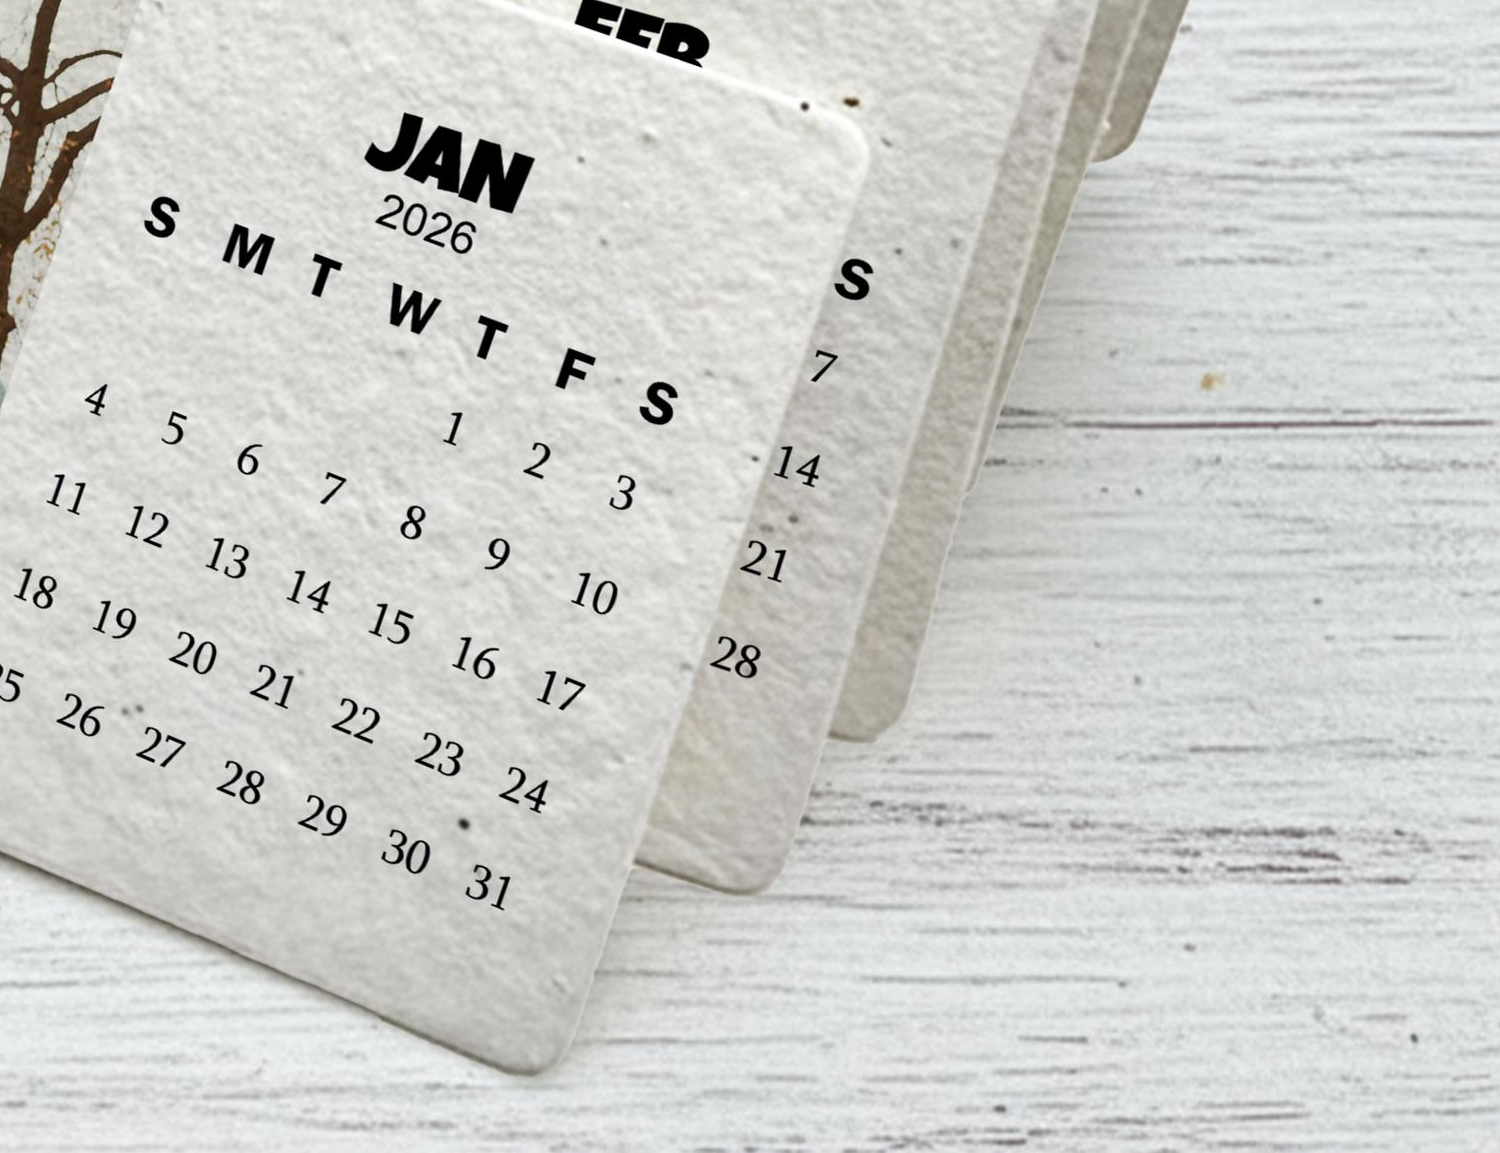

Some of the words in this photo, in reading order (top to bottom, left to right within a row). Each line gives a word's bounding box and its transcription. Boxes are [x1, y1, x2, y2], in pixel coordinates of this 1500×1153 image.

[364, 112, 535, 214] JAN
[375, 194, 477, 255] 2026
[143, 196, 181, 239] S
[222, 223, 275, 276] M
[311, 253, 343, 298] T
[389, 282, 442, 335] W
[476, 314, 509, 360] T
[555, 347, 597, 390] F
[639, 381, 678, 426] S
[834, 258, 874, 301] S
[811, 349, 839, 383] 7
[84, 383, 108, 417] 4
[161, 411, 188, 445] 5
[237, 443, 263, 476] 6
[320, 471, 347, 505] 7
[400, 505, 426, 540] 8
[484, 538, 511, 570] 9
[571, 572, 618, 615] 10
[443, 412, 463, 447] 1
[523, 442, 551, 480] 2
[609, 474, 636, 511] 3
[773, 445, 821, 488] 14
[46, 474, 86, 516] 11
[125, 505, 169, 549] 12
[205, 537, 250, 579] 13
[286, 570, 331, 614] 14
[368, 603, 414, 645] 15
[452, 636, 500, 680] 16
[536, 670, 587, 711] 17
[739, 540, 787, 583] 21
[13, 568, 58, 610] 18
[92, 600, 137, 639] 19
[168, 631, 217, 675] 20
[249, 664, 294, 710] 21
[331, 697, 381, 744] 22
[414, 732, 464, 777] 23
[498, 766, 549, 814] 24
[709, 636, 761, 679] 28
[56, 693, 105, 737] 26
[135, 726, 187, 768] 27
[216, 760, 265, 805] 28
[297, 794, 348, 837] 29
[381, 829, 431, 875] 30
[465, 864, 511, 911] 31
